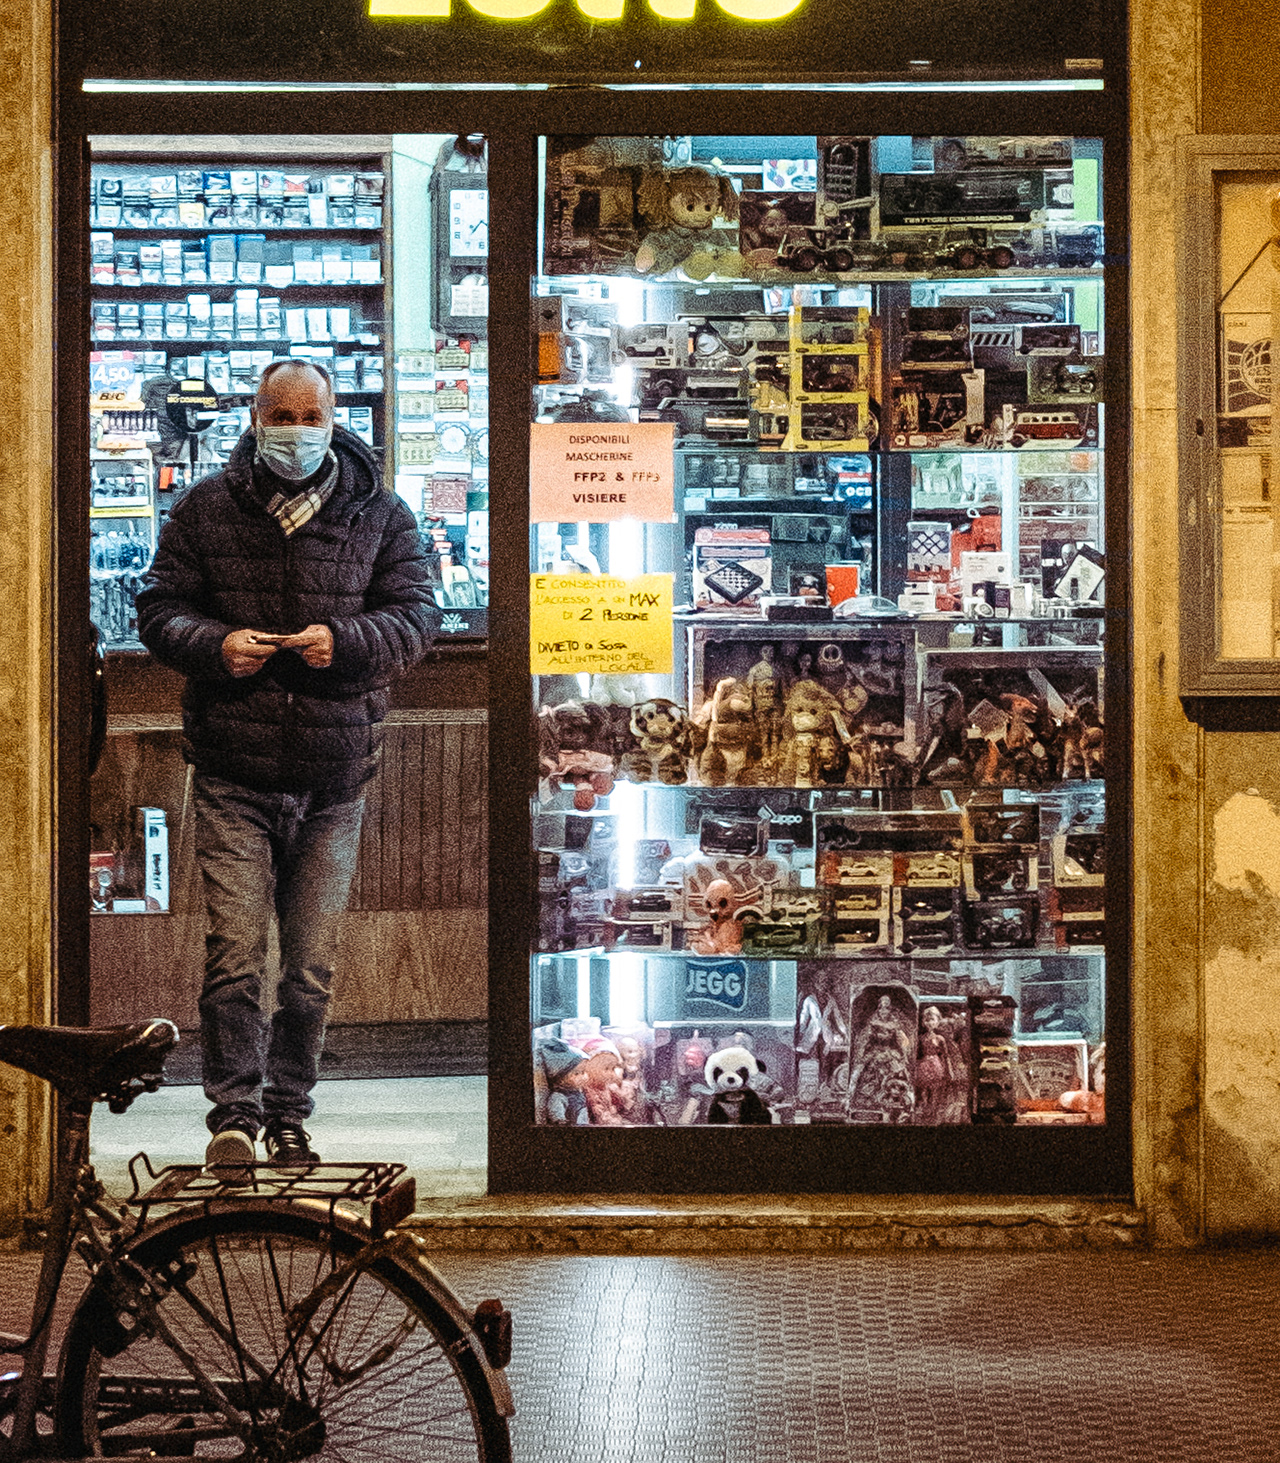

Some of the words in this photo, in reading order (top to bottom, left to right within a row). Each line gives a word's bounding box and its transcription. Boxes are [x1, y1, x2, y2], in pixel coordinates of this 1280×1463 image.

[569, 435, 630, 445] DISPONIBILI
[565, 452, 634, 462] MASCHERINE
[574, 472, 607, 482] FFP2
[615, 472, 625, 482] &
[573, 493, 627, 503] VISIERE
[629, 592, 661, 607] MAX
[579, 608, 594, 621] 2
